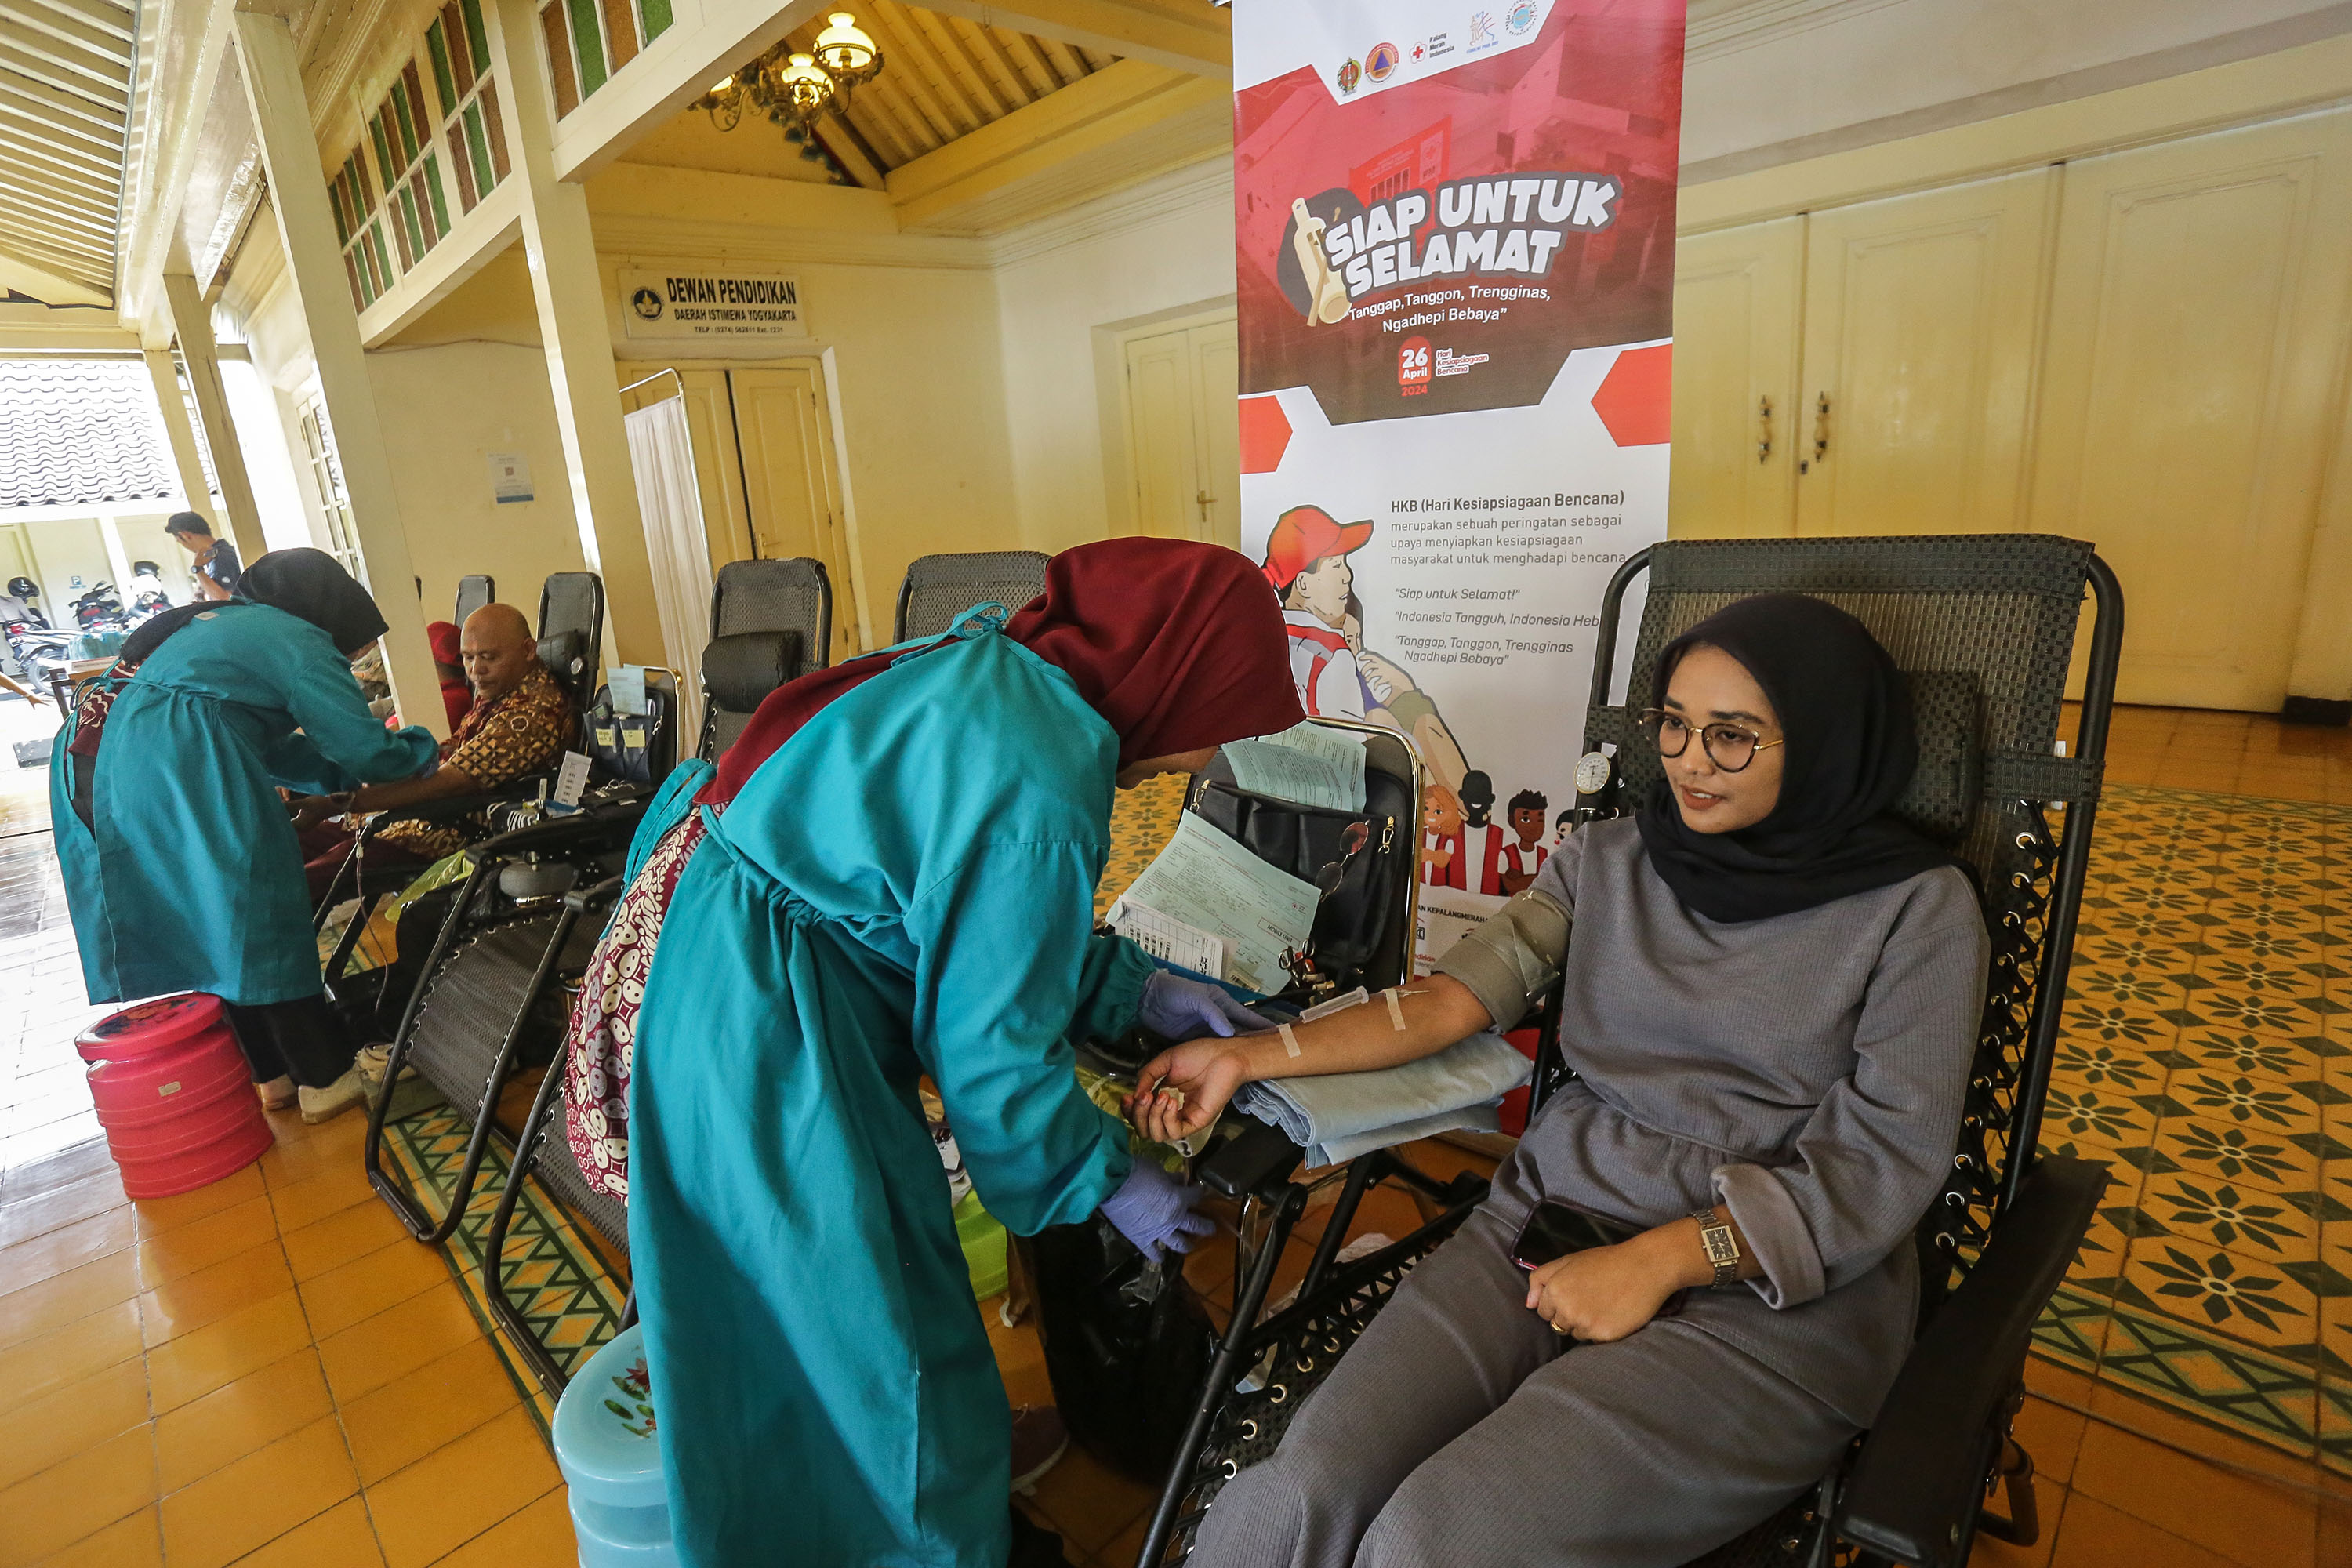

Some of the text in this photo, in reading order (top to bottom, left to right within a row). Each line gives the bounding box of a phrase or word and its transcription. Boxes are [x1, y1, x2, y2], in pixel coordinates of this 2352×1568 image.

[1429, 41, 1446, 50] Merah
[1429, 45, 1455, 59] Indonesia
[1325, 179, 1617, 266] SIAP UNTUK
[1345, 230, 1561, 297] SELAMAT
[666, 277, 717, 303] DEWAN
[719, 279, 797, 305] PENDIDIKAN
[1468, 285, 1552, 302] Trengginas,
[674, 309, 797, 322] DAERAH ISTIMEWA YOGYAKARTA
[1382, 309, 1445, 333] Ngadhepi
[1402, 347, 1428, 368] 26
[1437, 349, 1451, 358] Hari
[1437, 355, 1488, 366] Kesiapsiagaan
[1403, 366, 1428, 380] April
[1437, 366, 1468, 375] Bencana
[1401, 383, 1428, 397] 2024
[1391, 490, 1625, 513] HKB (Hari Kesiapsiagaan Bencana)
[1391, 514, 1622, 534] merupakan sebuah peringatan sebagai
[1391, 534, 1583, 550] upaya menyiapkan kesiapsiagaan
[1391, 554, 1454, 567] masyarakat
[1457, 552, 1490, 564] untuk
[1493, 551, 1567, 566] menghadapi
[1395, 589, 1521, 601] "Siap untuk Selamat!"
[1395, 612, 1600, 627] "Indonesia Tangguh, Indonesia Heb
[1395, 636, 1573, 653] "Tanggap, Tanggon, Trengginas
[1404, 650, 1509, 666] Ngadhepi Bebaya"
[1427, 906, 1488, 923] KEPALANGMERAH
[1267, 924, 1293, 943] MOBILE UNIT
